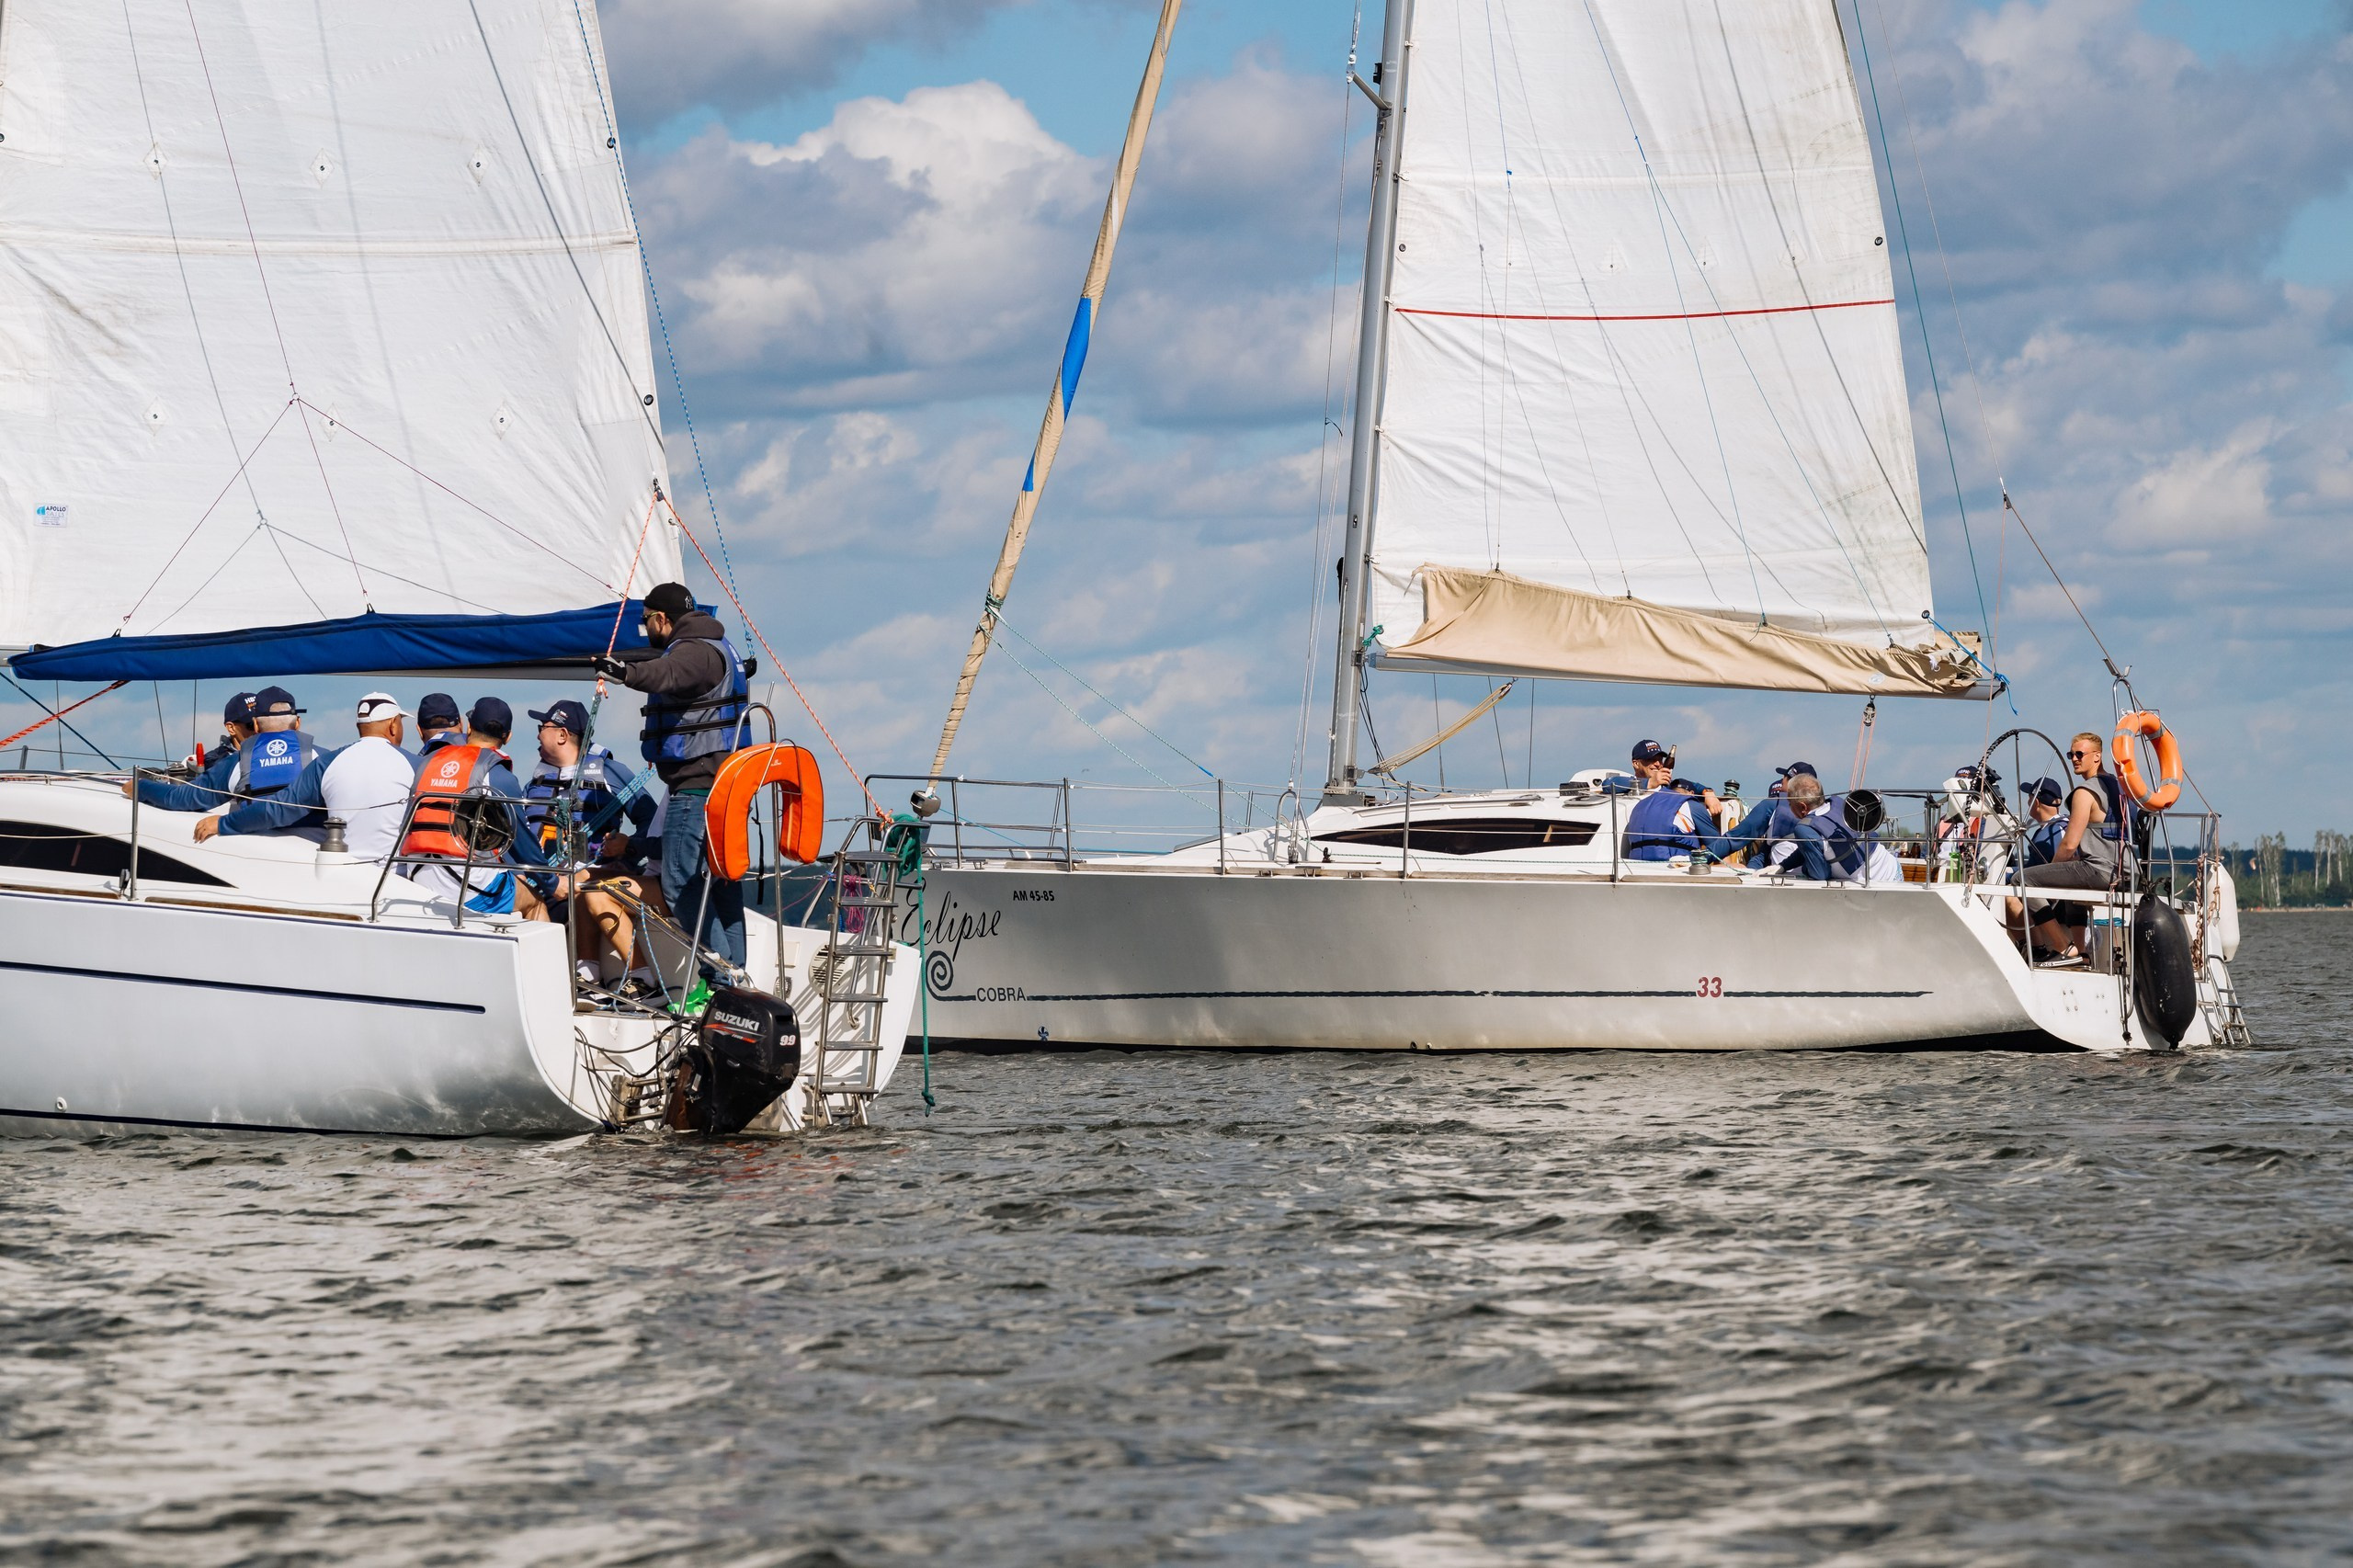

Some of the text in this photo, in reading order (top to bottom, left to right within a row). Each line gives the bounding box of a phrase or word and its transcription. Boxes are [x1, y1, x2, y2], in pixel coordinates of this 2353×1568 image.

[259, 756, 293, 767] YAMAHA
[430, 778, 458, 788] YAMAHA
[1012, 890, 1055, 902] AM 45-85
[901, 876, 1001, 962] Eclipse
[976, 986, 1027, 1002] COBRA
[1697, 976, 1722, 998] 33
[714, 1010, 760, 1031] SUZUKI
